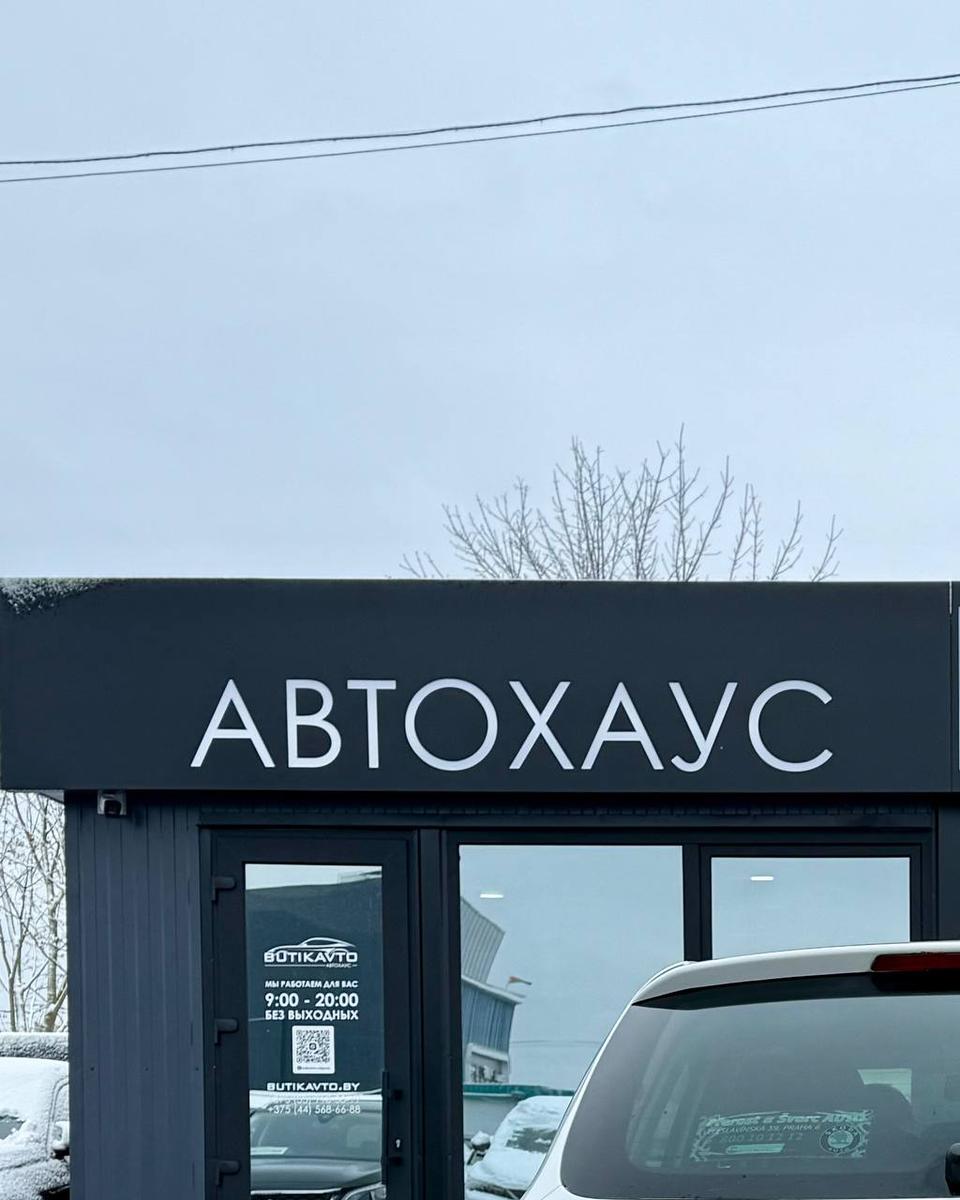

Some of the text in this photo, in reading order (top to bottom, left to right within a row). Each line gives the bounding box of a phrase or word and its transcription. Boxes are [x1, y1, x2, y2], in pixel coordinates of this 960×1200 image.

[190, 678, 833, 772] АВТОХАУС
[264, 951, 358, 963] BUTIKAVTO
[265, 980, 358, 989] МЫ РАБОТАЕМ ДЛЯ ВАС
[265, 993, 299, 1007] 9:00
[315, 993, 359, 1007] 20:00
[265, 1010, 358, 1021] БЕЗ ВЫХОДНЫХ
[267, 1082, 361, 1091] BUTIKAVTO.BY
[268, 1104, 361, 1118] +375 (44) 568-66-88
